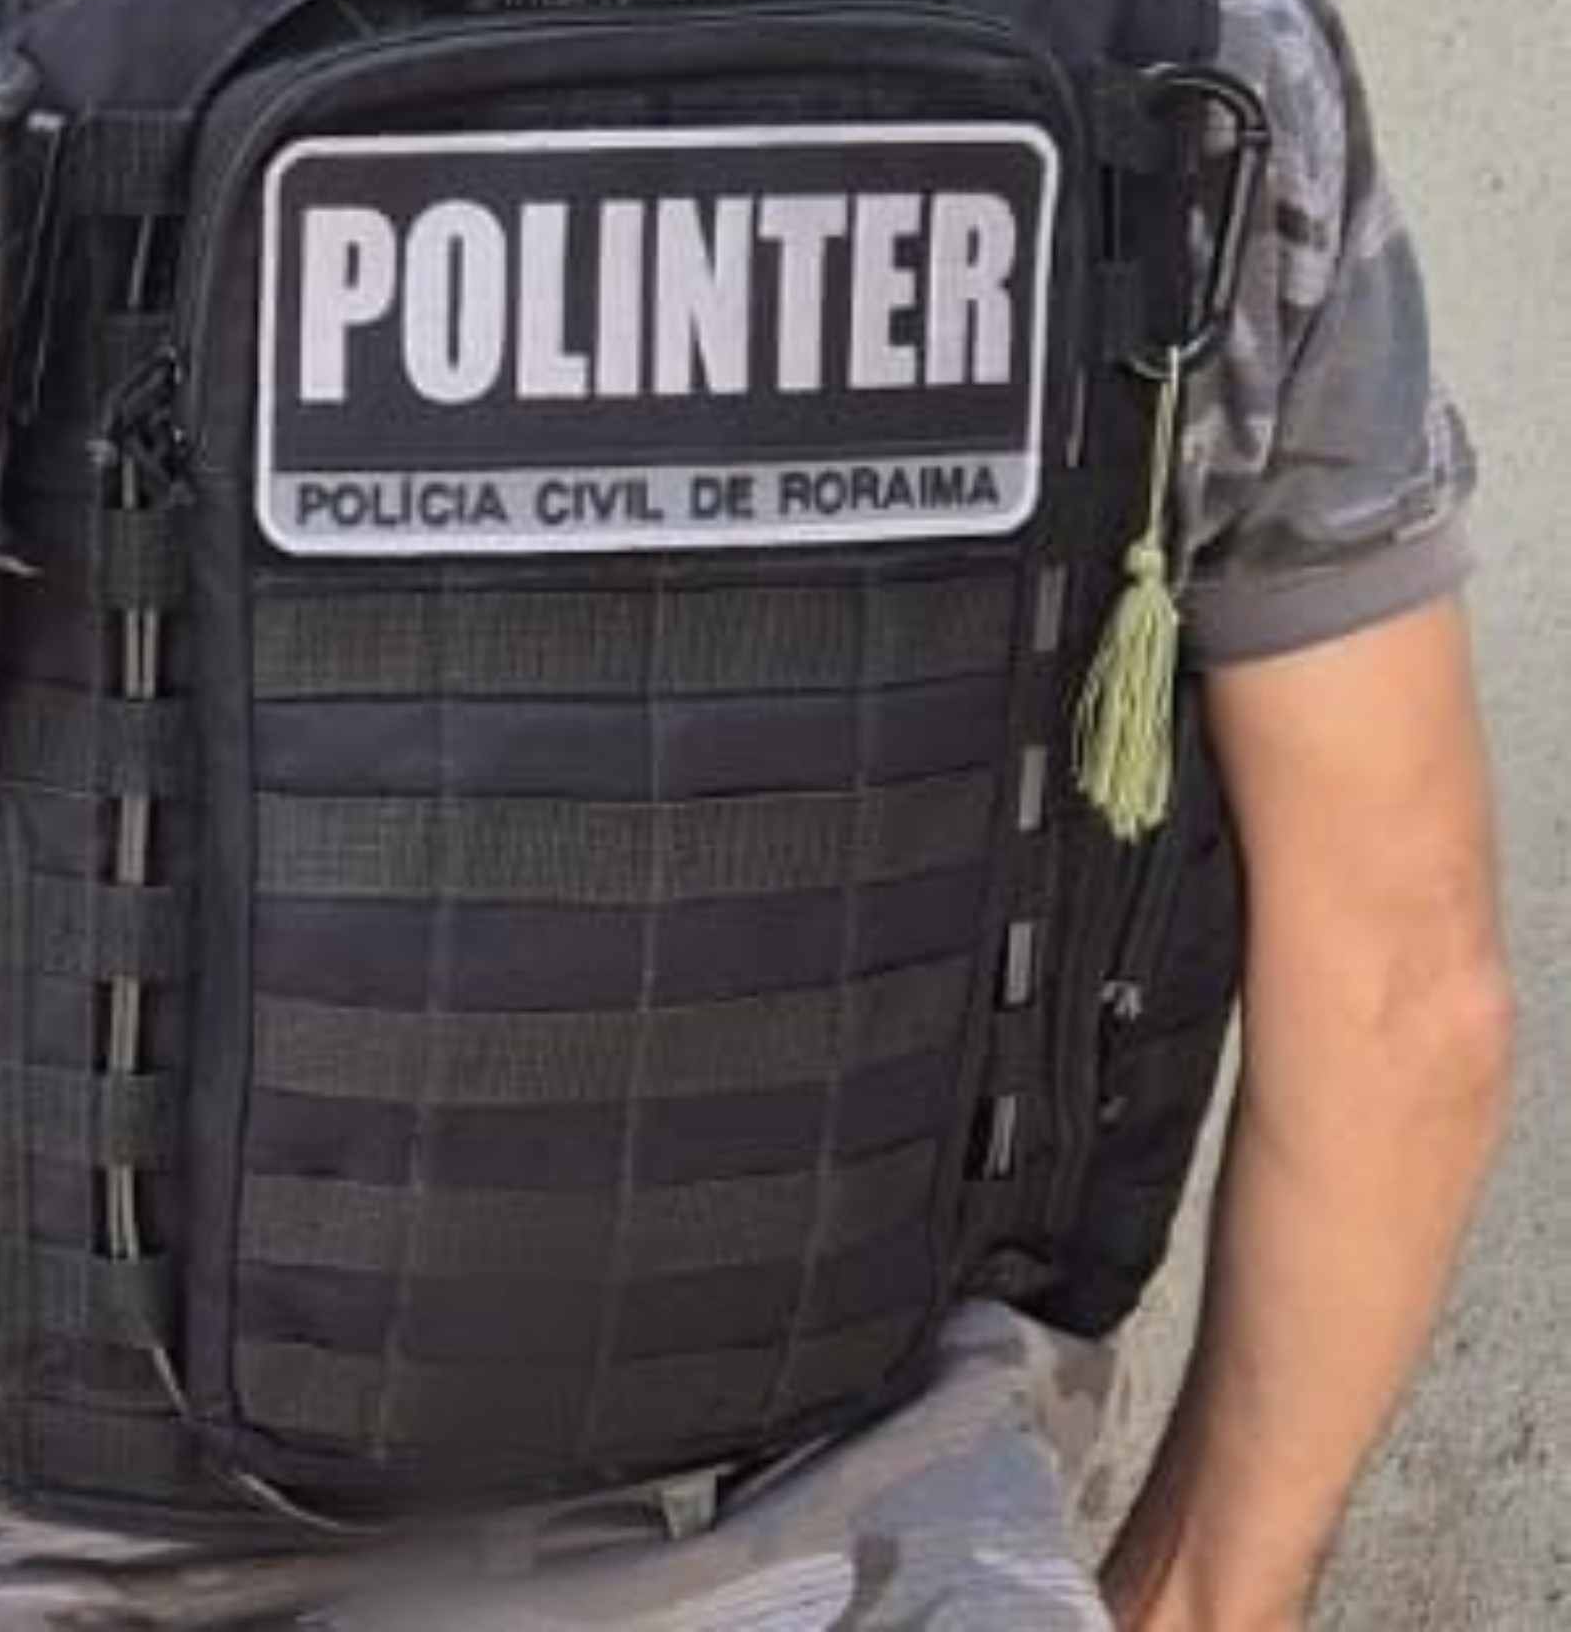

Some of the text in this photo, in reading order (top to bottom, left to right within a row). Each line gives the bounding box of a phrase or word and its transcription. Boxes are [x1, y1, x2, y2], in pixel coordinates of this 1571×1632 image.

[299, 192, 1017, 406] POLINTER
[295, 463, 1000, 527] POLÍCIA CIVIL DE RORAIMA
